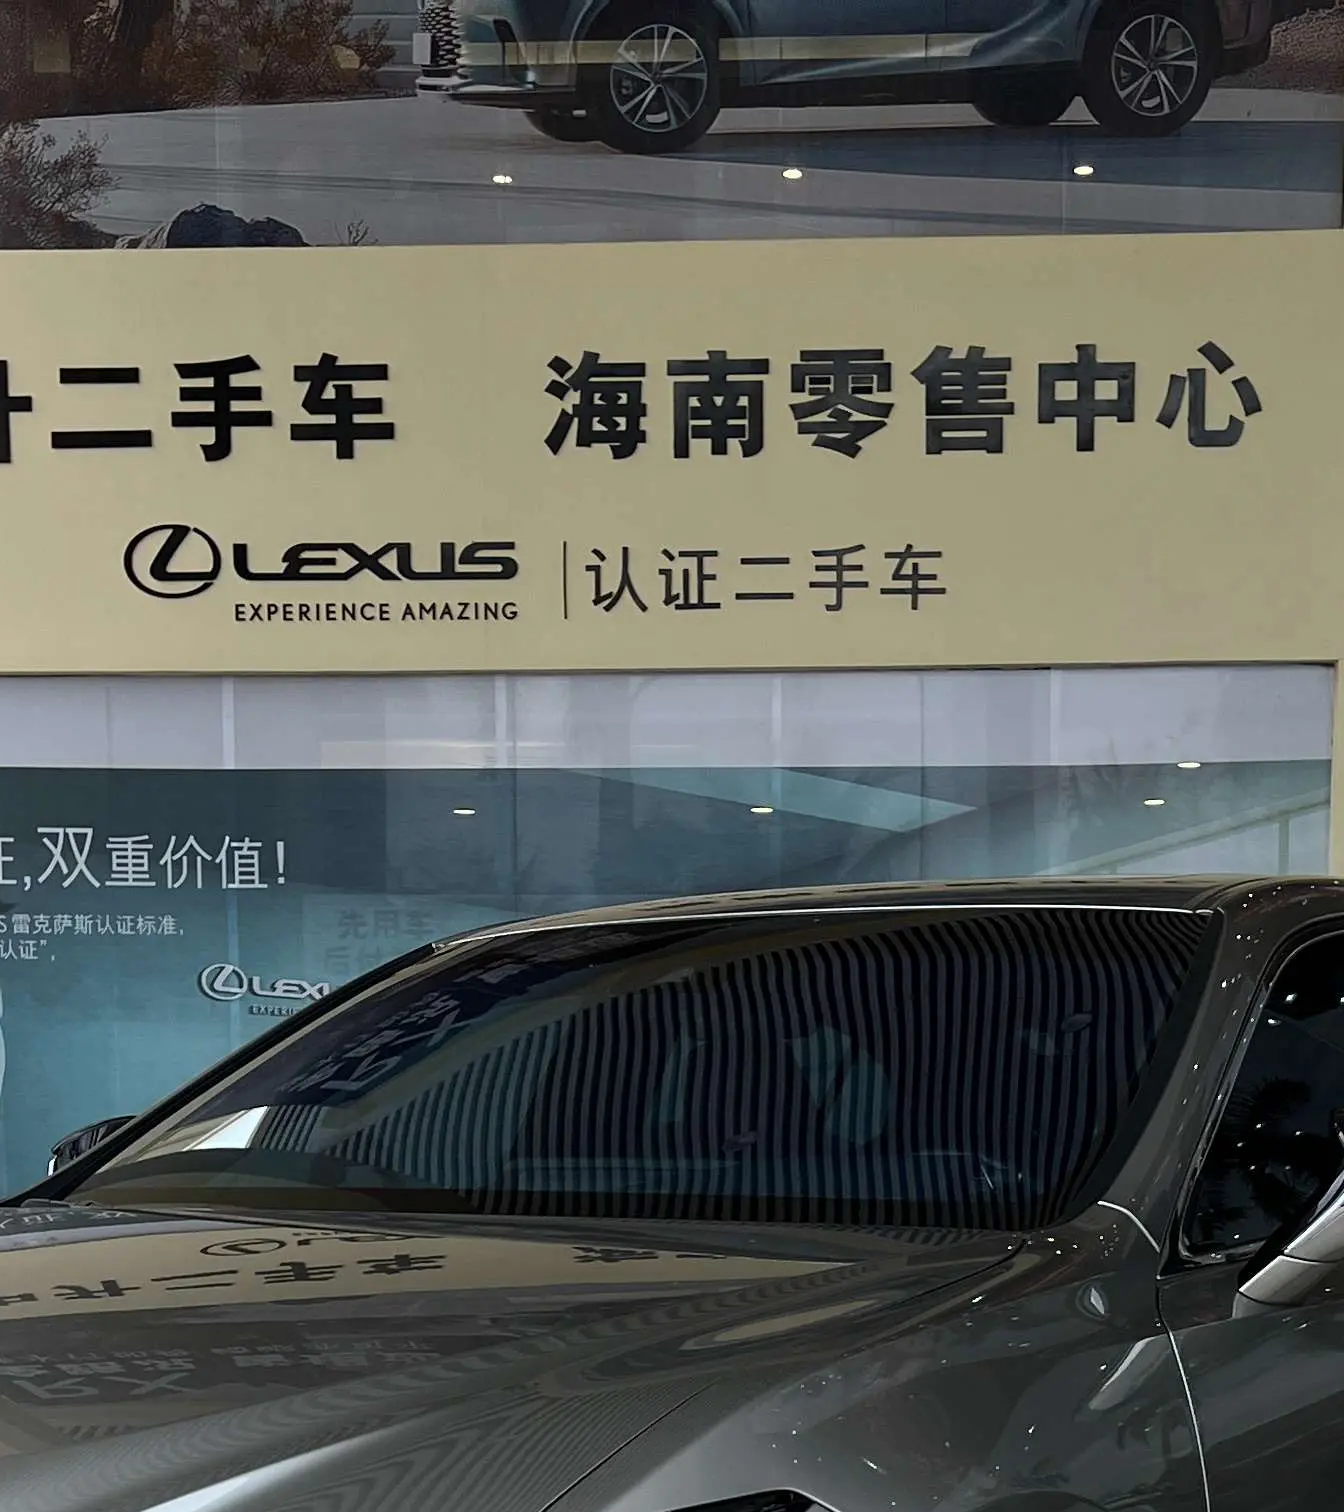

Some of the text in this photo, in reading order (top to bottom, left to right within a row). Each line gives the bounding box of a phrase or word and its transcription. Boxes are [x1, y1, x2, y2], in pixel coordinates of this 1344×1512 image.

[543, 341, 1263, 460] 海南零售中心
[233, 540, 519, 582] LEXUS
[584, 543, 947, 612] 认证二手车
[234, 601, 520, 623] EXPERIENCE AMAZING
